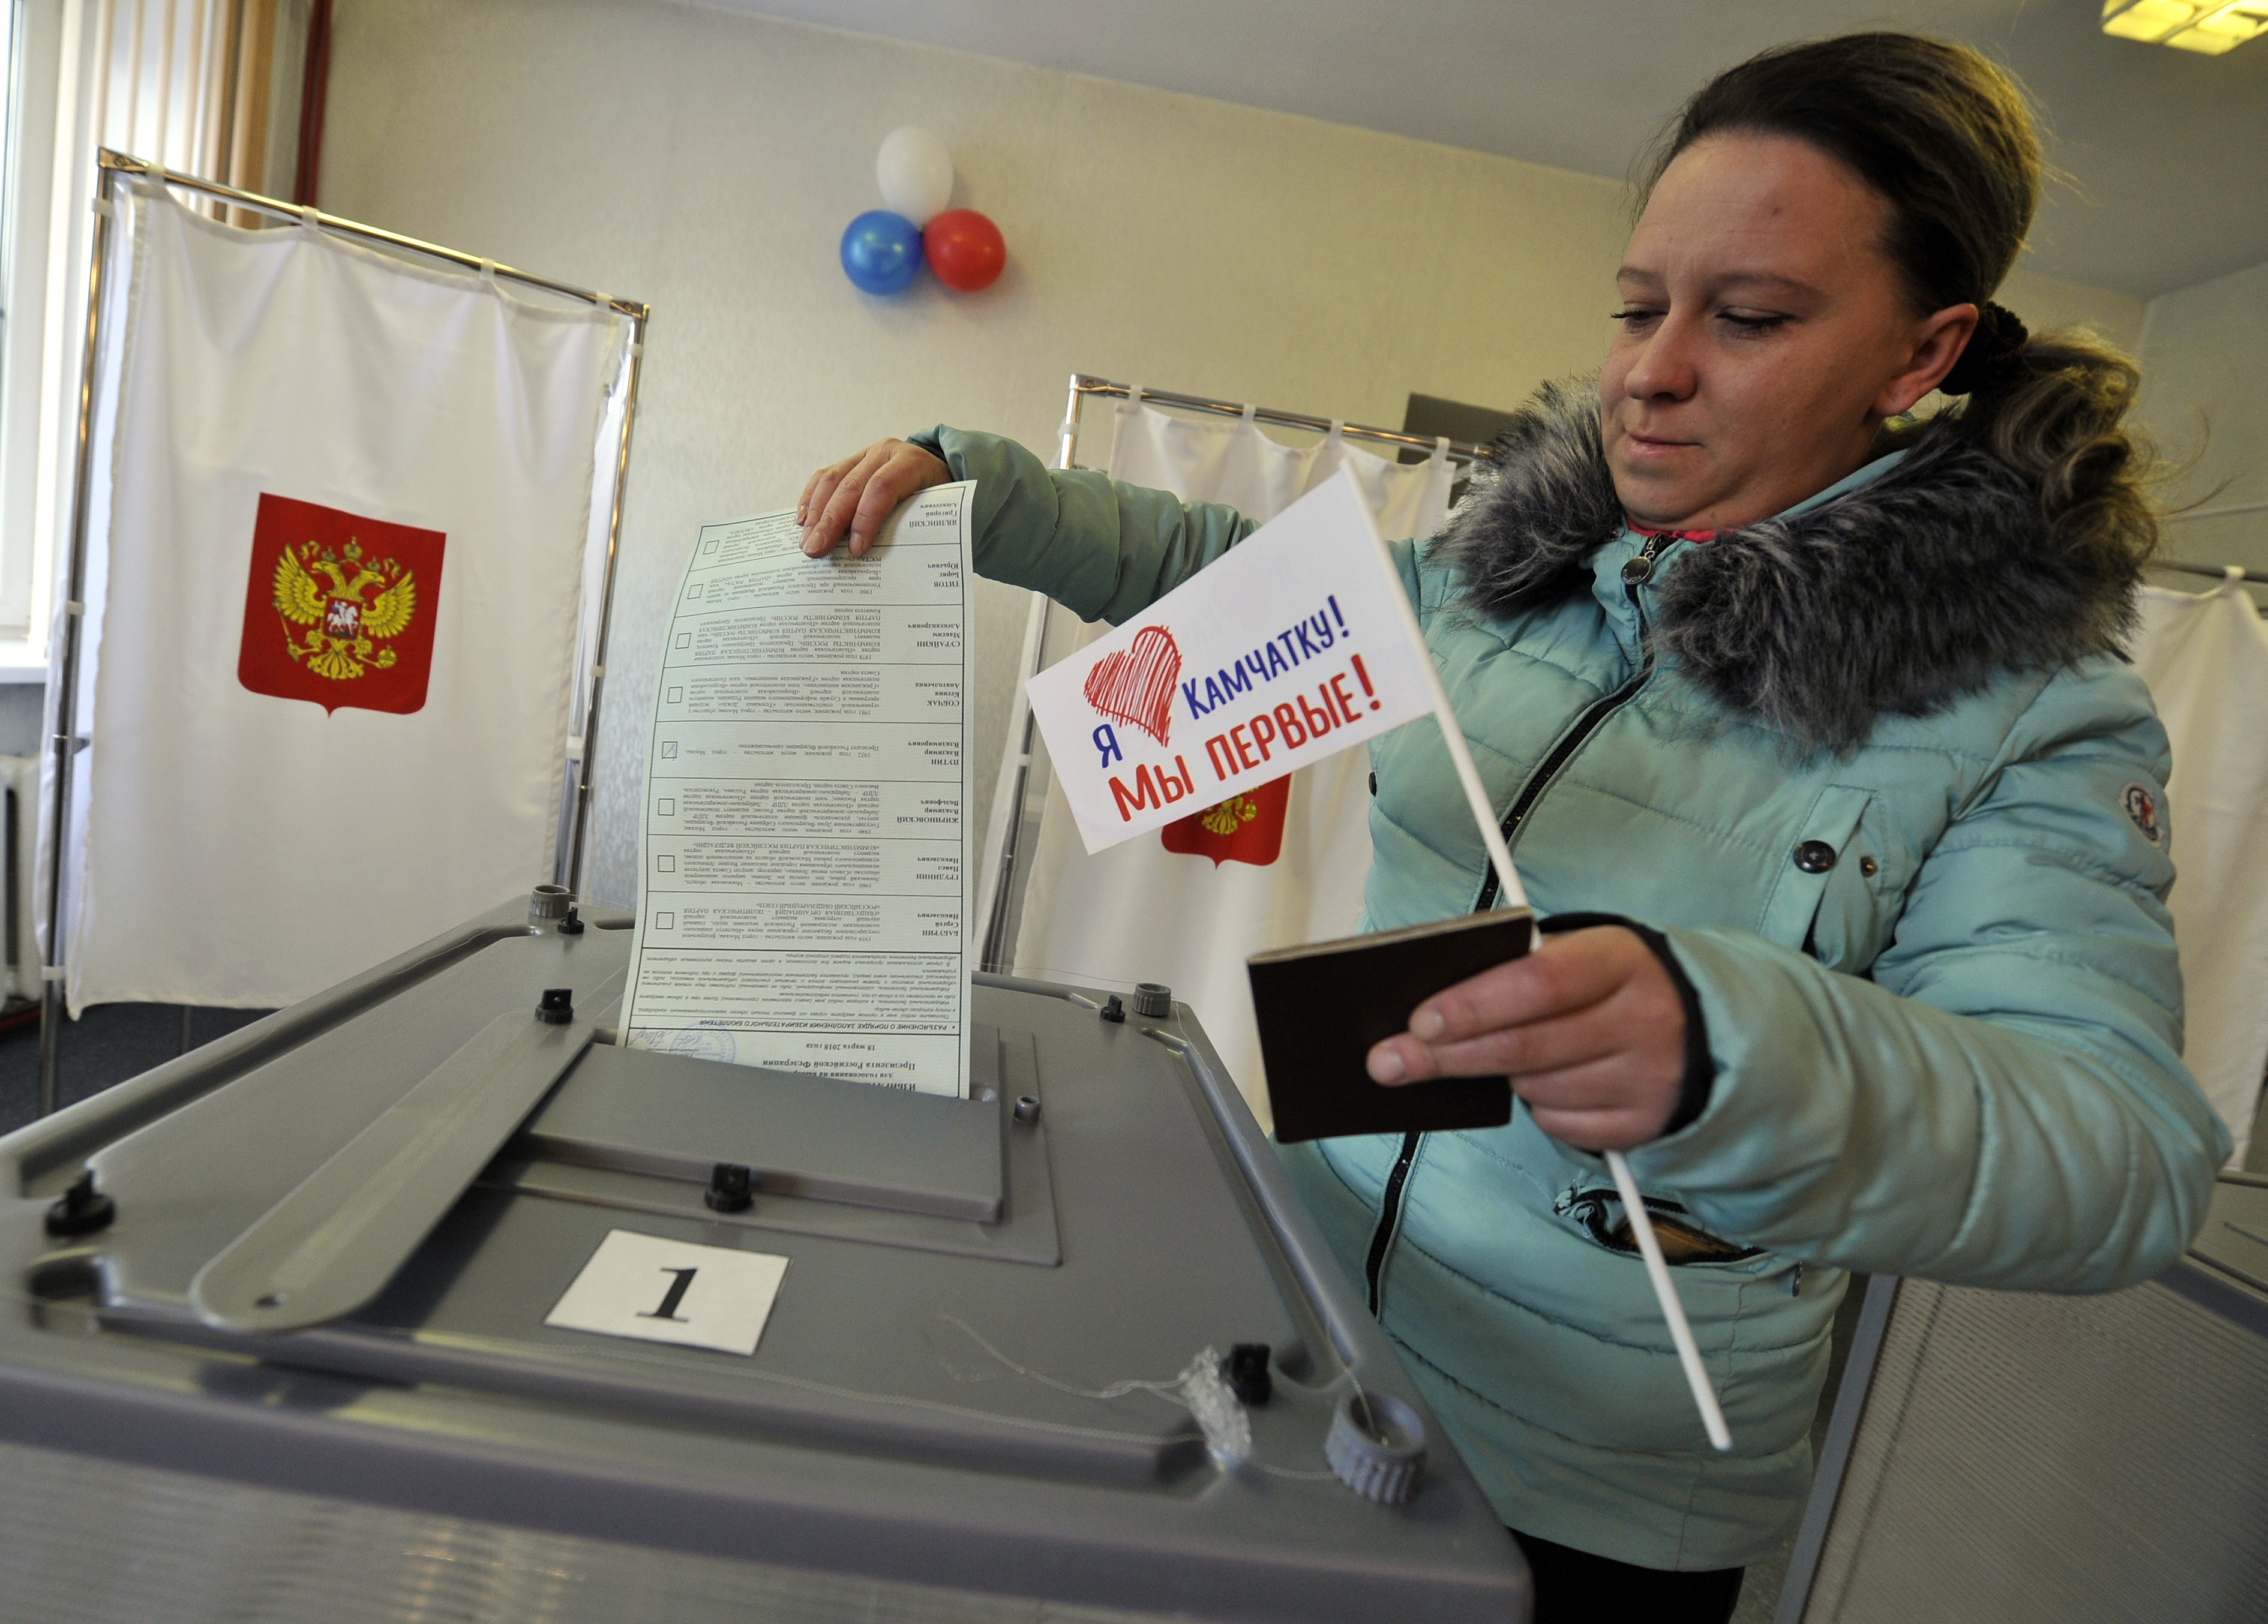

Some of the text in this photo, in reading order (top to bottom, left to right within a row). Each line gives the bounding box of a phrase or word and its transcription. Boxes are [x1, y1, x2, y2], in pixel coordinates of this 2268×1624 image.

[909, 519, 957, 529] ЯВЛИНСКИЙ
[1092, 595, 1350, 768] Я КАМЧАТКУ!
[1205, 654, 1381, 781] ПЕРВЫЕ!
[763, 1059, 916, 1070] Президента Российской Федерации
[636, 1267, 698, 1323] 1
